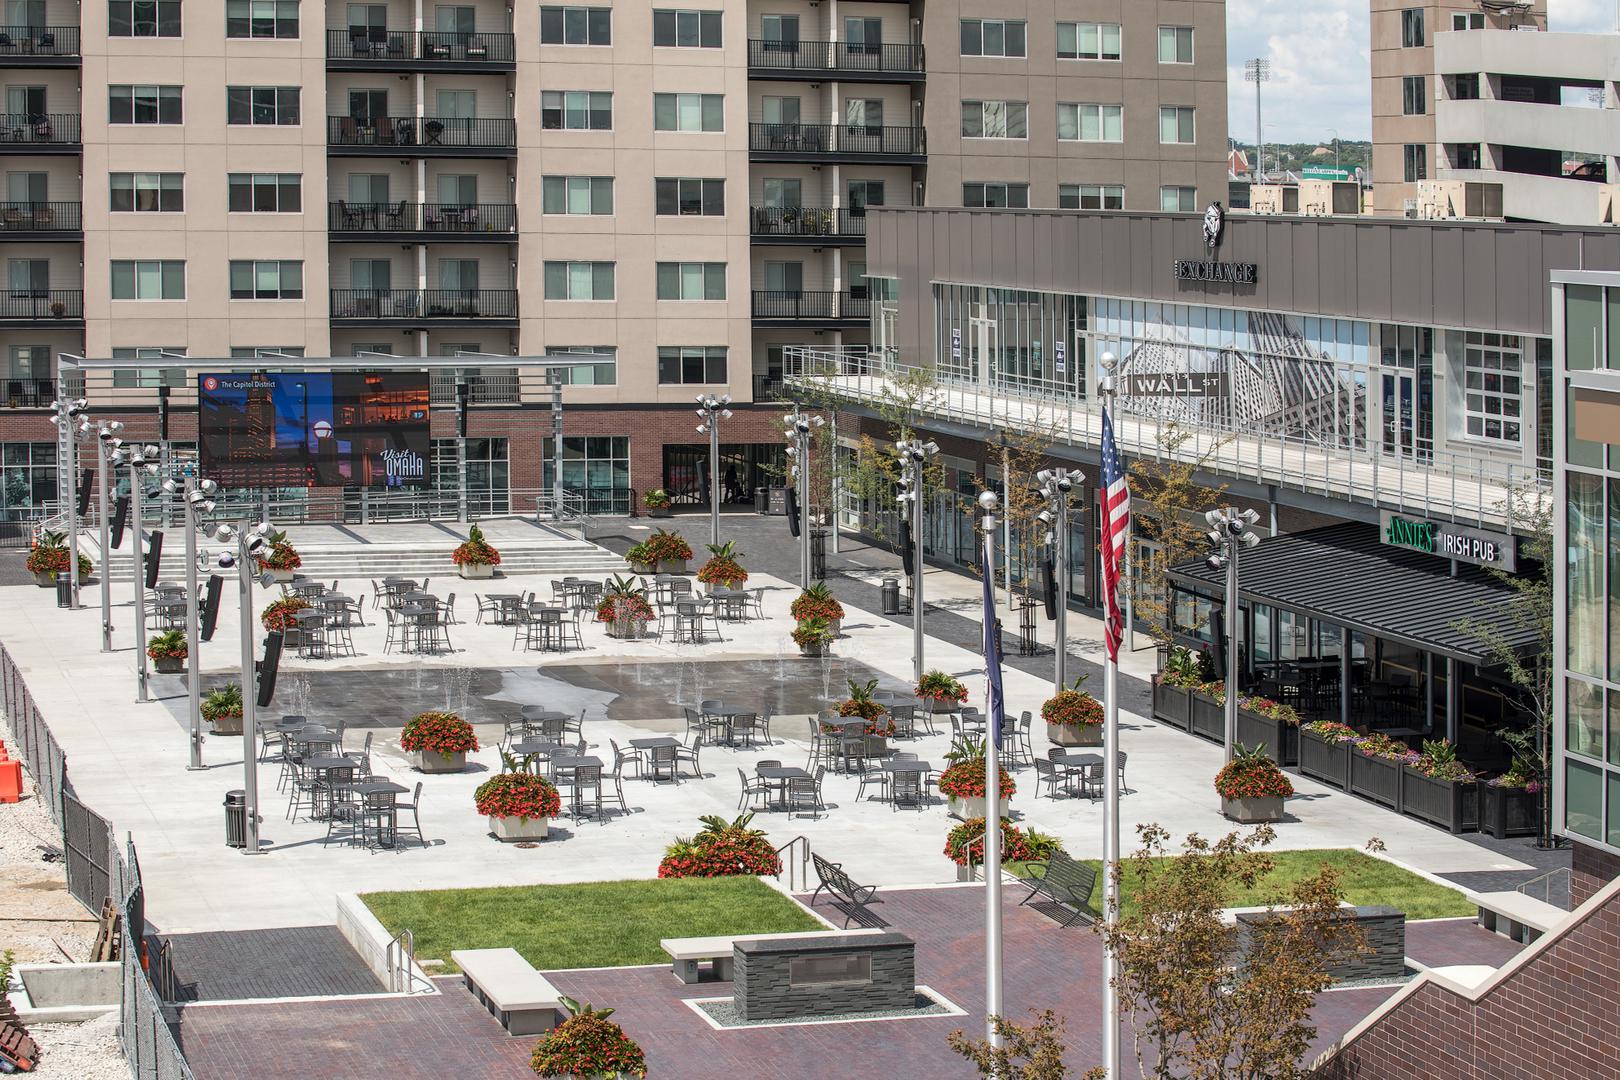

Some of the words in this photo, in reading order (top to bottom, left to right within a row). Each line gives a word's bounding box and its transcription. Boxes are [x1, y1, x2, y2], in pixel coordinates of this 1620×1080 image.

[1178, 261, 1255, 284] EXCHANGE
[233, 381, 254, 389] Capitol
[1137, 379, 1202, 392] WALL
[380, 449, 410, 460] Visit
[386, 452, 423, 476] OMAHA
[1386, 516, 1432, 552] ANNIE'S
[1443, 534, 1470, 556] IRISH
[1473, 540, 1494, 561] PUB
